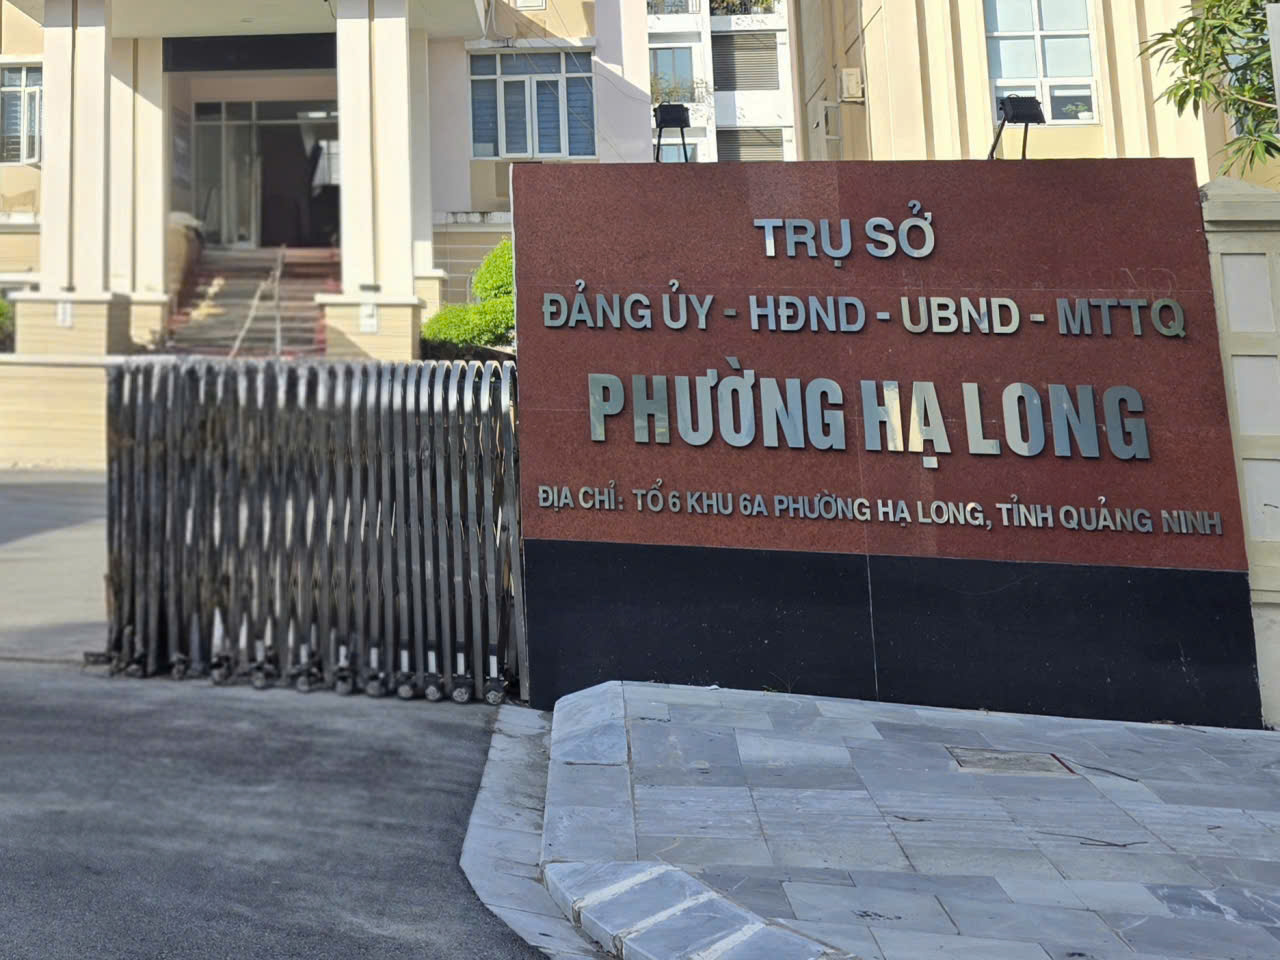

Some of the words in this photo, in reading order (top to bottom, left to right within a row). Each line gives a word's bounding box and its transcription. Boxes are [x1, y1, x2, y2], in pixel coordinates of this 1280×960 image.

[753, 218, 852, 268] TRỤ
[865, 200, 935, 258] SỞ
[542, 279, 652, 329] ĐẢNG
[662, 279, 714, 330] ỦY
[749, 295, 866, 332] HĐND
[900, 296, 1021, 334] UBND
[1056, 297, 1187, 338] MTTQ
[588, 356, 847, 450] PHƯỜNG
[860, 379, 952, 469] HẠ
[961, 381, 1151, 460] LONG
[538, 485, 574, 512] ĐỊA
[632, 478, 664, 513] TỔ
[669, 490, 681, 513] 6
[686, 491, 734, 516] KHU
[739, 493, 768, 516] 6A
[773, 490, 871, 522] PHƯỜNG
[877, 499, 912, 527] HẠ
[917, 500, 992, 530] LONG,
[996, 494, 1054, 528] TỈNH
[1059, 496, 1152, 533] QUẢNG
[1161, 510, 1222, 535] NINH
